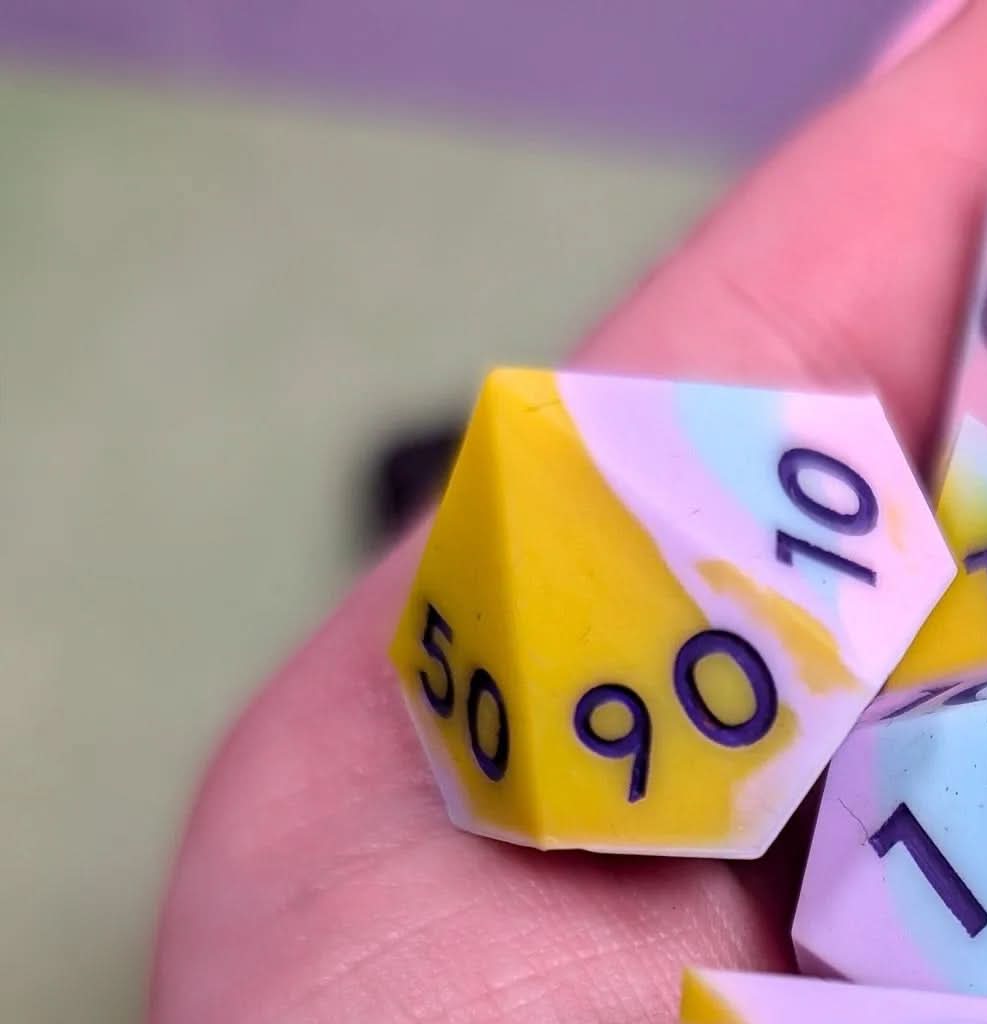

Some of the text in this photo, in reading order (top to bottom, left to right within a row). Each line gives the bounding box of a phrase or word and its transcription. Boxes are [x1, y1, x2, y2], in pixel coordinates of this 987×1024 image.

[775, 446, 879, 588] 10
[418, 602, 510, 783] 50
[573, 628, 778, 804] 90
